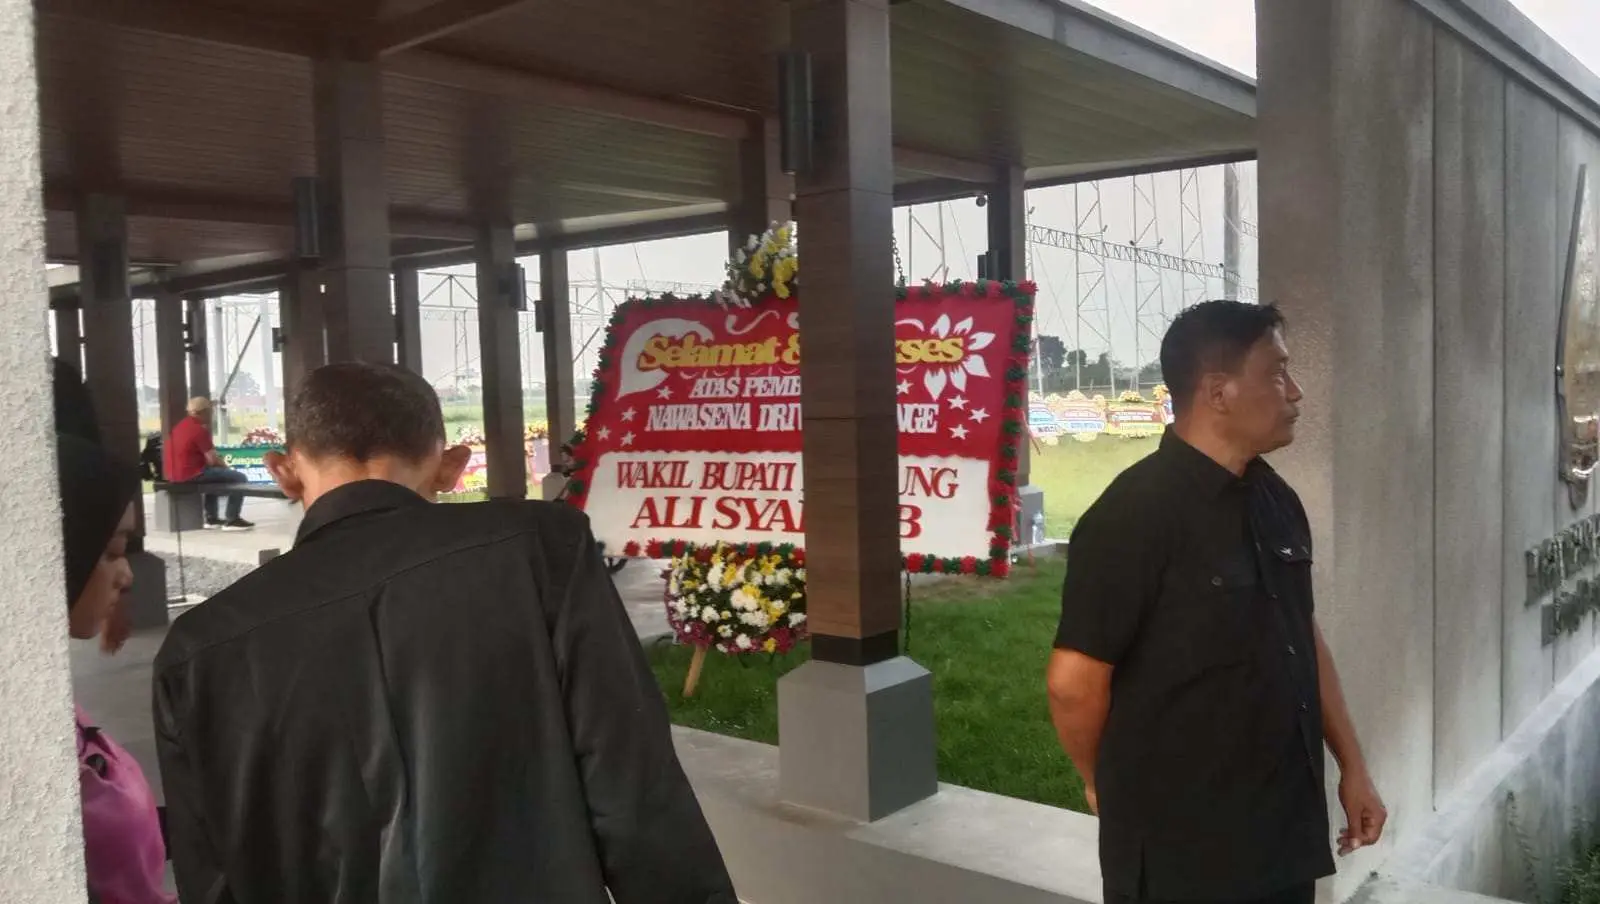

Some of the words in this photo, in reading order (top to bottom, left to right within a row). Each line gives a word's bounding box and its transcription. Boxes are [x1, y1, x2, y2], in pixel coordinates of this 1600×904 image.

[637, 333, 781, 370] Selamat
[896, 337, 964, 364] ses
[688, 376, 741, 398] ATAS
[741, 375, 801, 397] PEMB
[644, 402, 752, 432] NAWASENA
[756, 402, 803, 432] DRI
[896, 403, 940, 434] NGE
[616, 460, 693, 489] WAKIL
[699, 461, 797, 492] BUPATI
[629, 496, 707, 529] ALI
